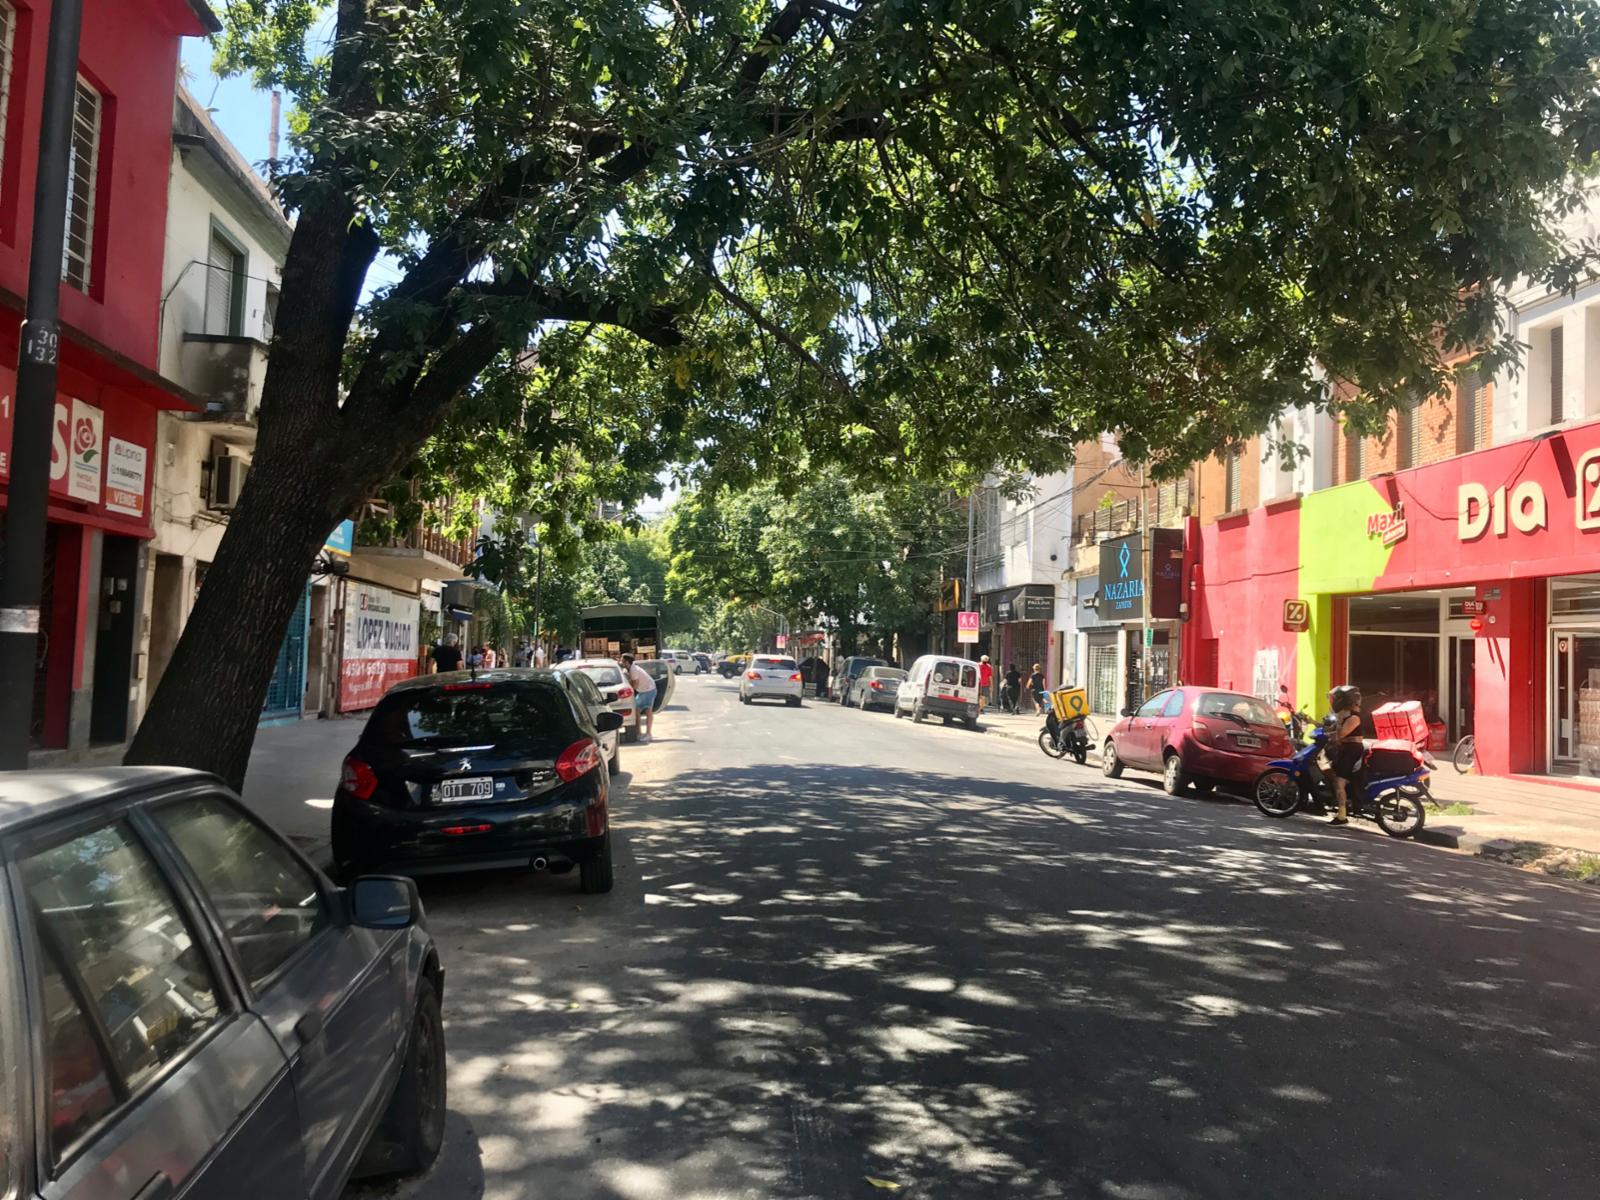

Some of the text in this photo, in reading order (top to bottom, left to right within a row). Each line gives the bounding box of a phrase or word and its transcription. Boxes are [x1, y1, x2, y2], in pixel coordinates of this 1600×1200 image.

[1105, 579, 1145, 600] NAZARIA
[443, 784, 463, 798] OTT
[471, 782, 491, 795] 709
